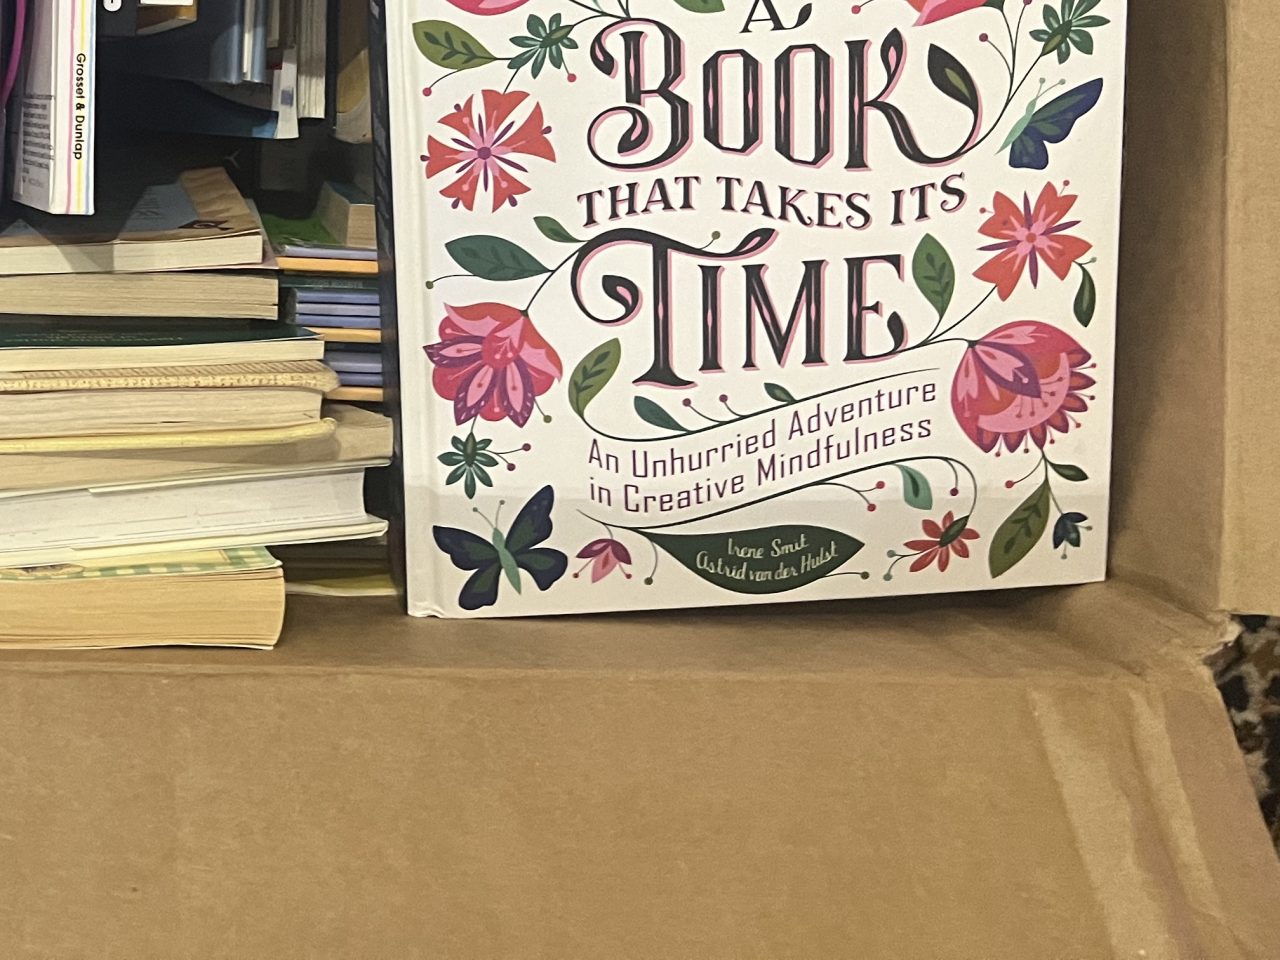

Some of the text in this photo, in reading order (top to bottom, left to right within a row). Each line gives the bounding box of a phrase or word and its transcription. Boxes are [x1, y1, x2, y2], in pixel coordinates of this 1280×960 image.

[73, 53, 87, 160] Grosset & Dunlap
[587, 17, 983, 172] BOOK
[577, 171, 968, 230] THAT TAKES ITS
[571, 227, 908, 389] TIME
[588, 382, 936, 478] An Unhurried Adventure
[589, 418, 932, 513] in Creative Mindfulness
[696, 541, 839, 582] Astrid van der Hulst
[727, 534, 809, 559] Irene Smit
